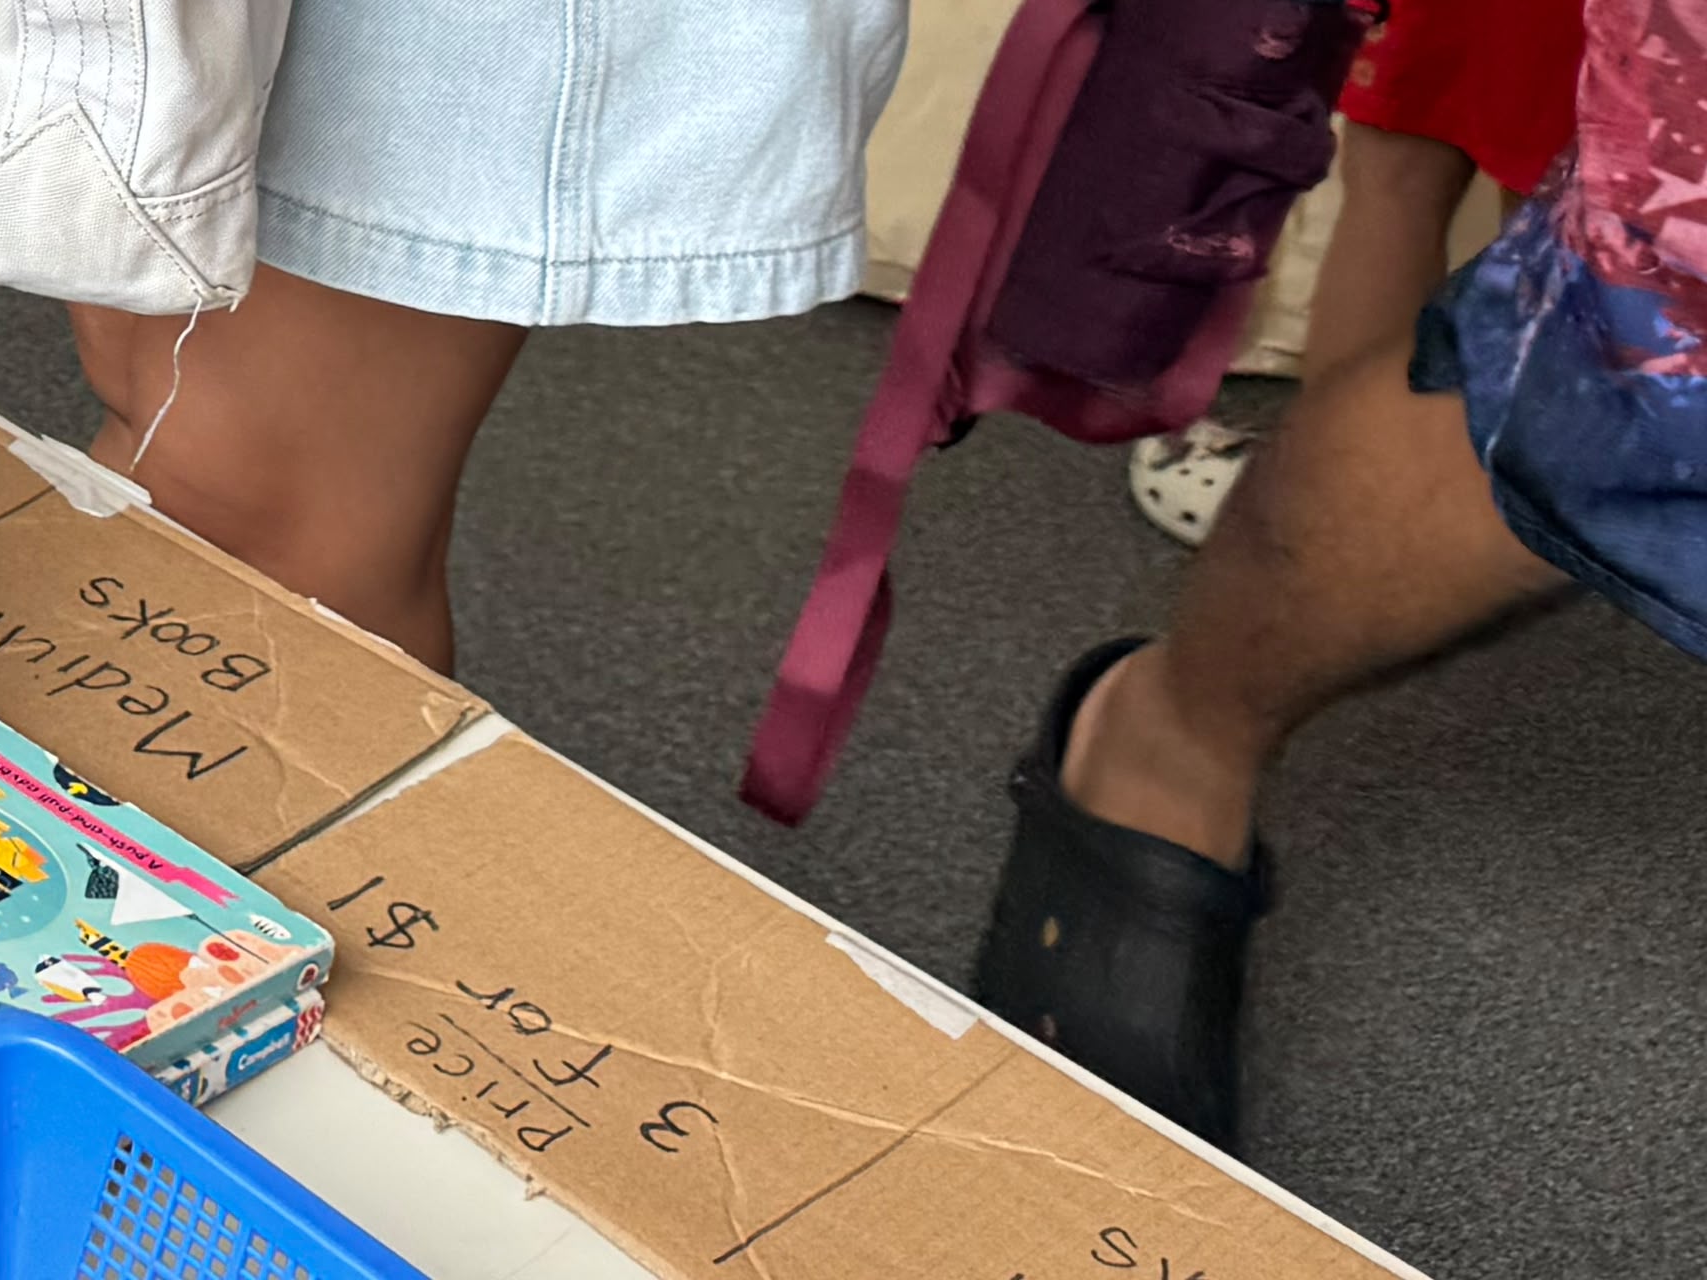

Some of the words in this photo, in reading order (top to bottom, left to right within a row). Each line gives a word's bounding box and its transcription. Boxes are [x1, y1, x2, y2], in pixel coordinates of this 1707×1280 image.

[78, 575, 273, 694] Books
[37, 792, 150, 861] push-and-pull
[147, 858, 164, 871] A
[325, 875, 442, 950] $1
[405, 1015, 575, 1153] Price
[638, 1101, 721, 1155] 3
